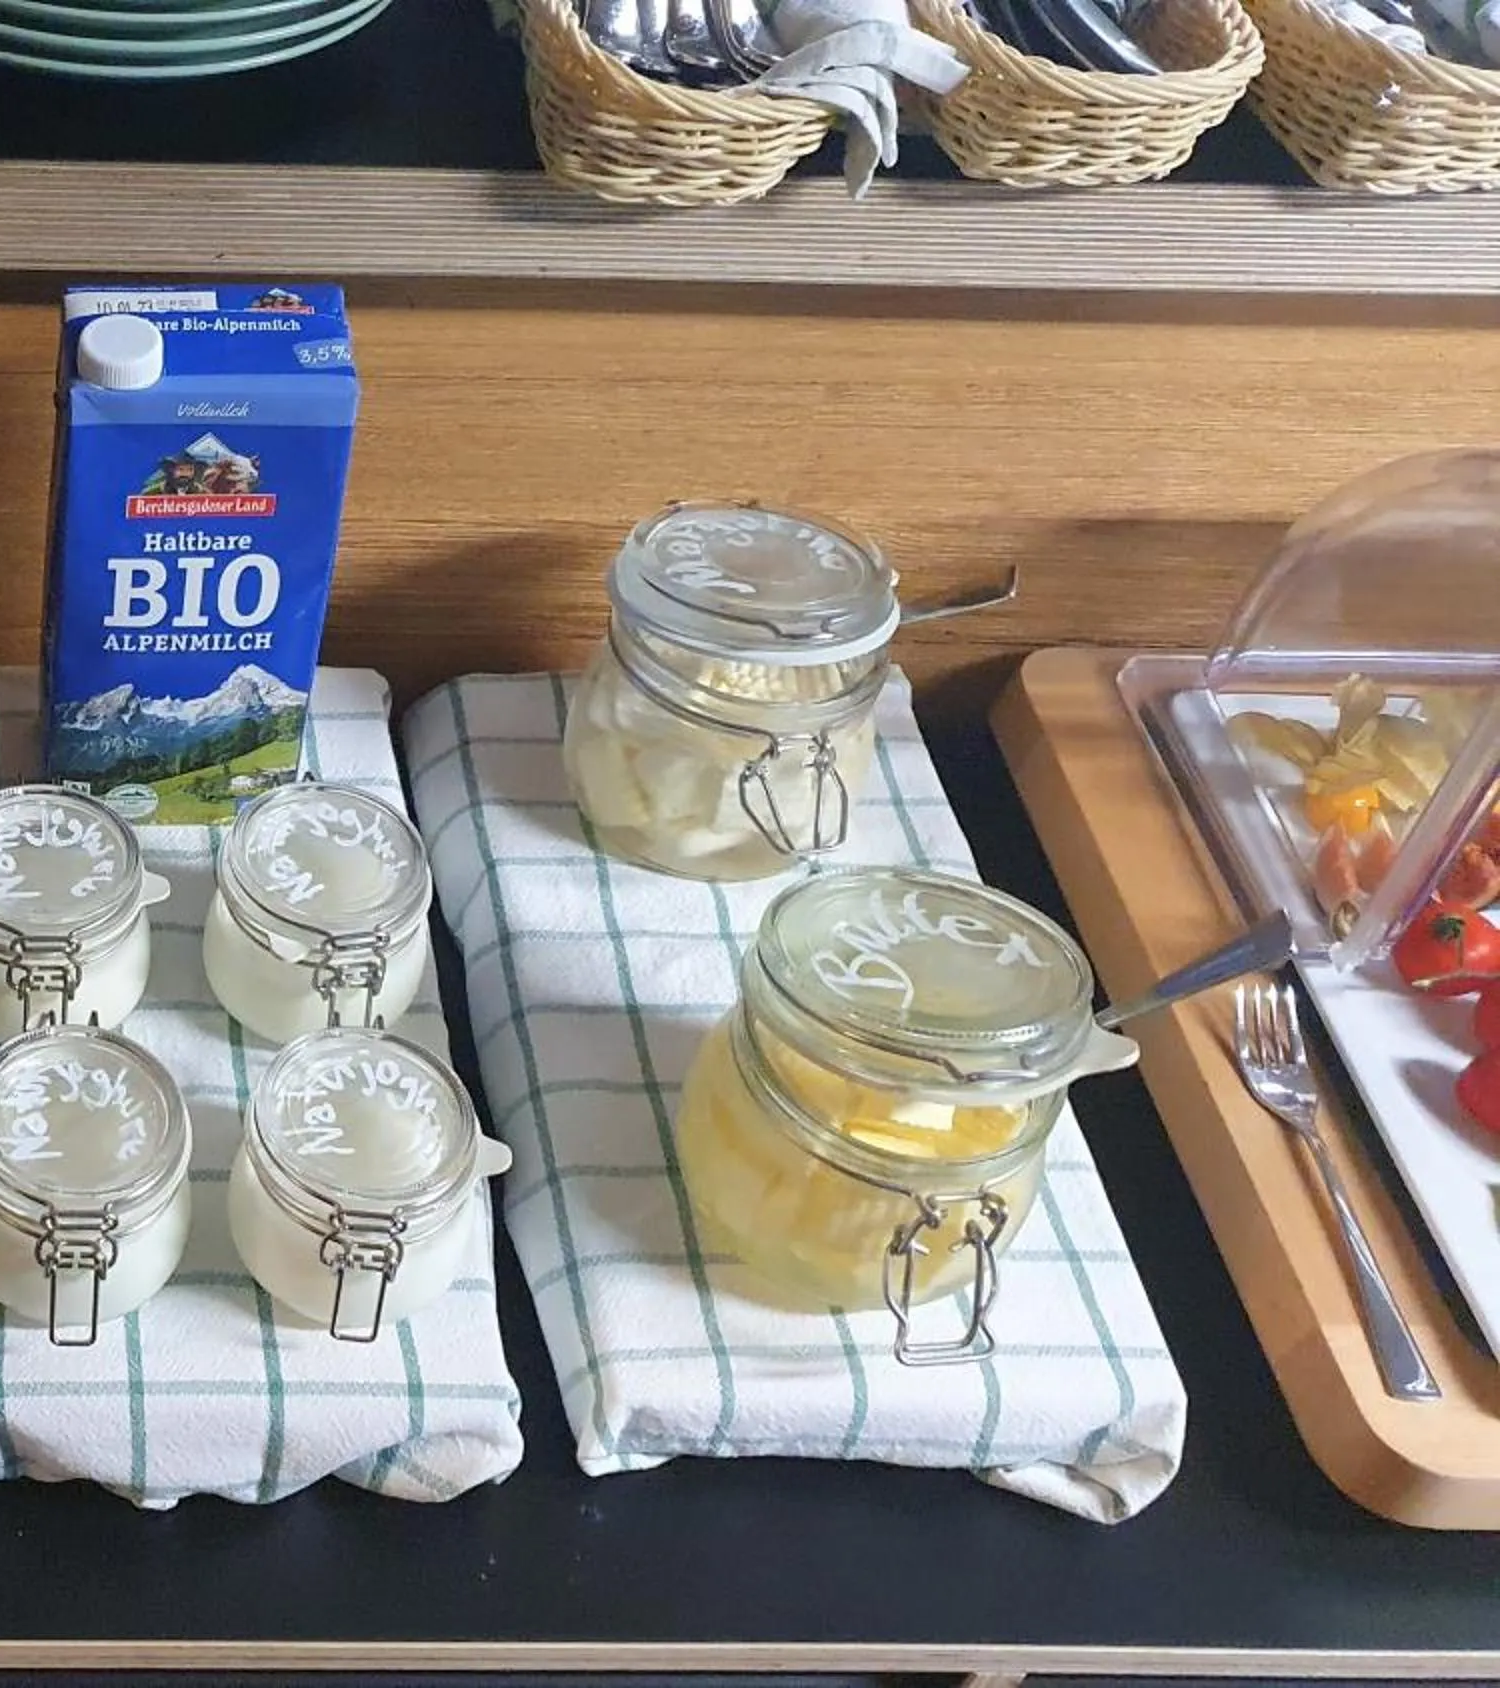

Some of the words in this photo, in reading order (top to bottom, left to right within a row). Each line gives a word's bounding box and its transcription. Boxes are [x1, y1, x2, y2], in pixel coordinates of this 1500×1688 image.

[183, 317, 302, 334] Bio-Alpenmilch
[177, 401, 251, 417] Vollmilch
[136, 499, 232, 516] Berchtesgadener
[235, 498, 267, 512] Land
[143, 530, 252, 553] Haltbare
[103, 554, 282, 628] BIO
[102, 631, 274, 652] ALPENMILCH
[810, 888, 1052, 1014] Butter
